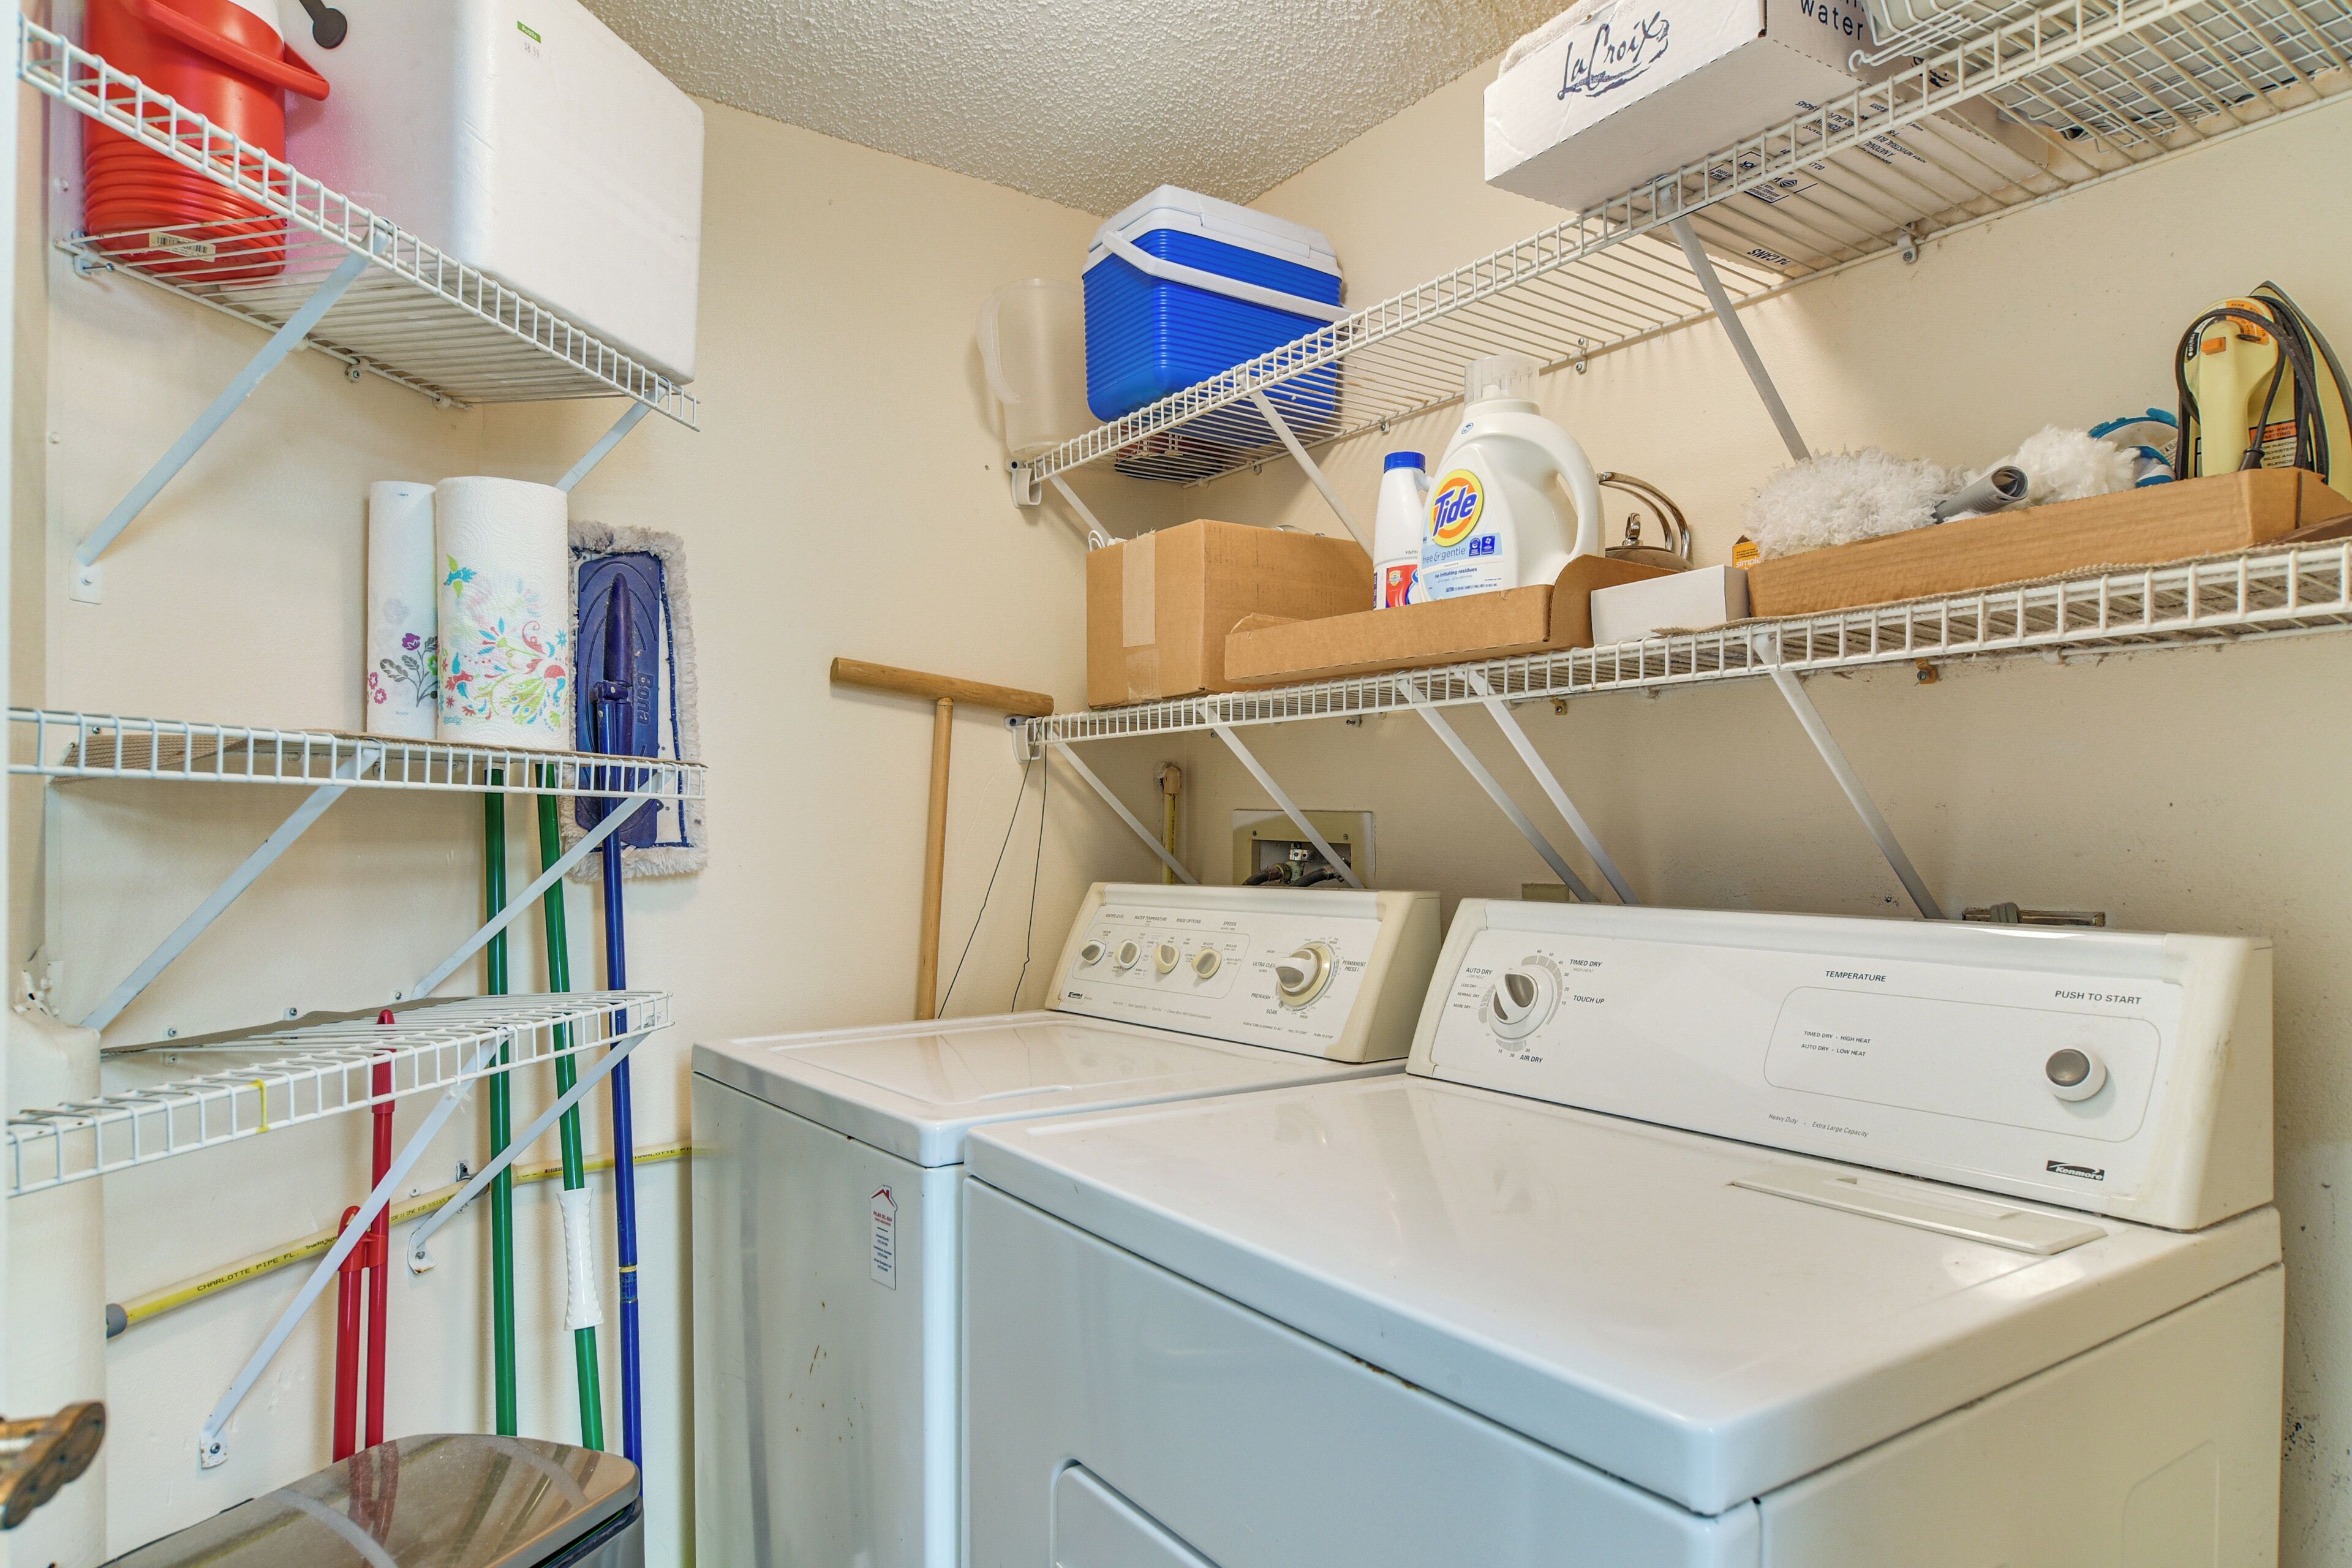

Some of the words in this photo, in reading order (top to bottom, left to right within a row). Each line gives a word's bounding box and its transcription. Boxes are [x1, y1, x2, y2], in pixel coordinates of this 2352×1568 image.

[1800, 0, 1864, 40] water
[1747, 248, 1779, 264] CANS
[1433, 484, 1477, 538] Tide
[1422, 554, 1433, 564] free
[1441, 547, 1466, 560] gentle
[638, 673, 654, 724] Bona
[1826, 970, 1887, 982] TEMPERATURE
[2055, 990, 2084, 1000] PUSH
[2087, 993, 2103, 1001] TO
[2105, 995, 2142, 1005] START
[1768, 1114, 1784, 1122] Heavy
[1826, 1124, 1843, 1133] Large
[1844, 1127, 1869, 1137] Capacity
[633, 1150, 675, 1159] HARLOTTE
[2055, 1166, 2103, 1180] Kenmore
[197, 1268, 251, 1291] CHARLOTTE
[256, 1257, 279, 1270] PIPE
